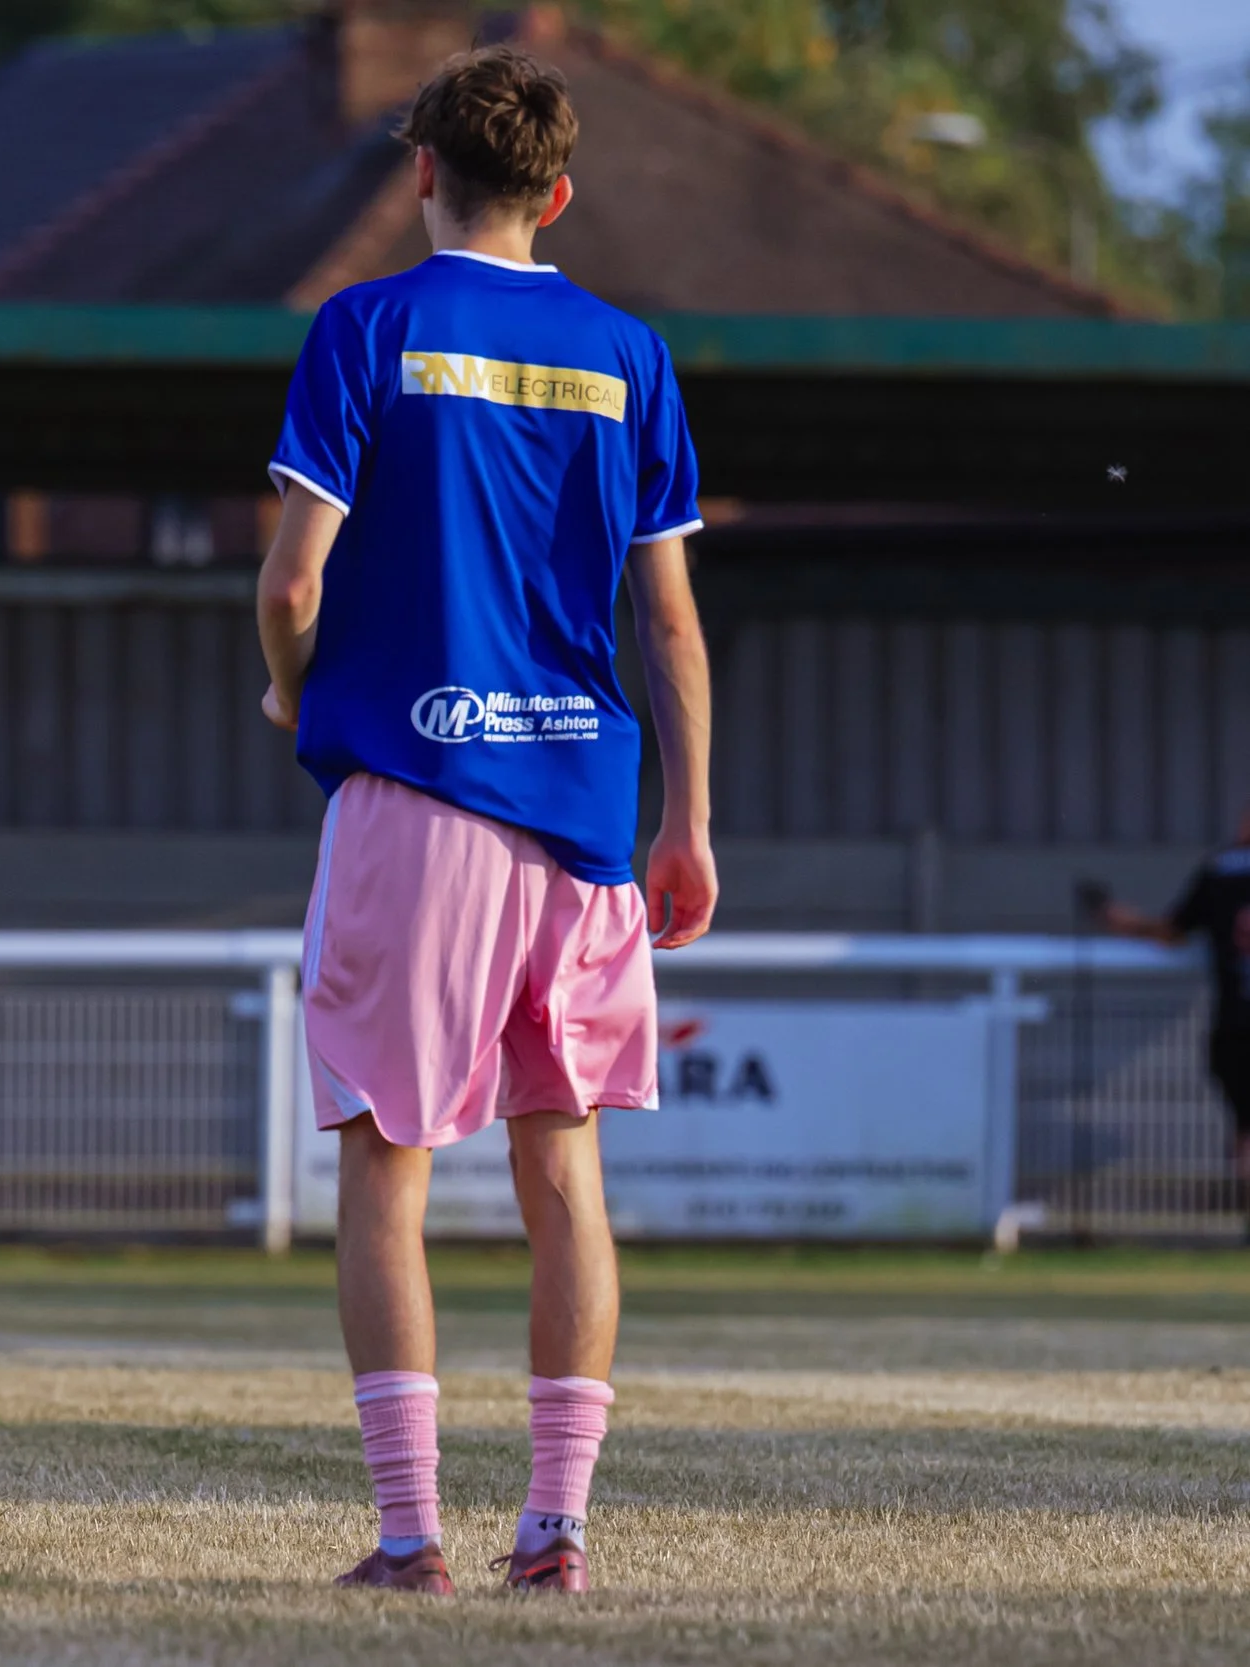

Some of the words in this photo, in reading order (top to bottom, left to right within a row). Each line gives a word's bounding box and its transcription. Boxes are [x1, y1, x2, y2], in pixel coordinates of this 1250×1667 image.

[491, 374, 622, 411] ELECTRICAL
[485, 692, 596, 713] Minuteman
[484, 713, 535, 732] Press
[541, 715, 599, 731] Ashton
[659, 1051, 778, 1103] RA
